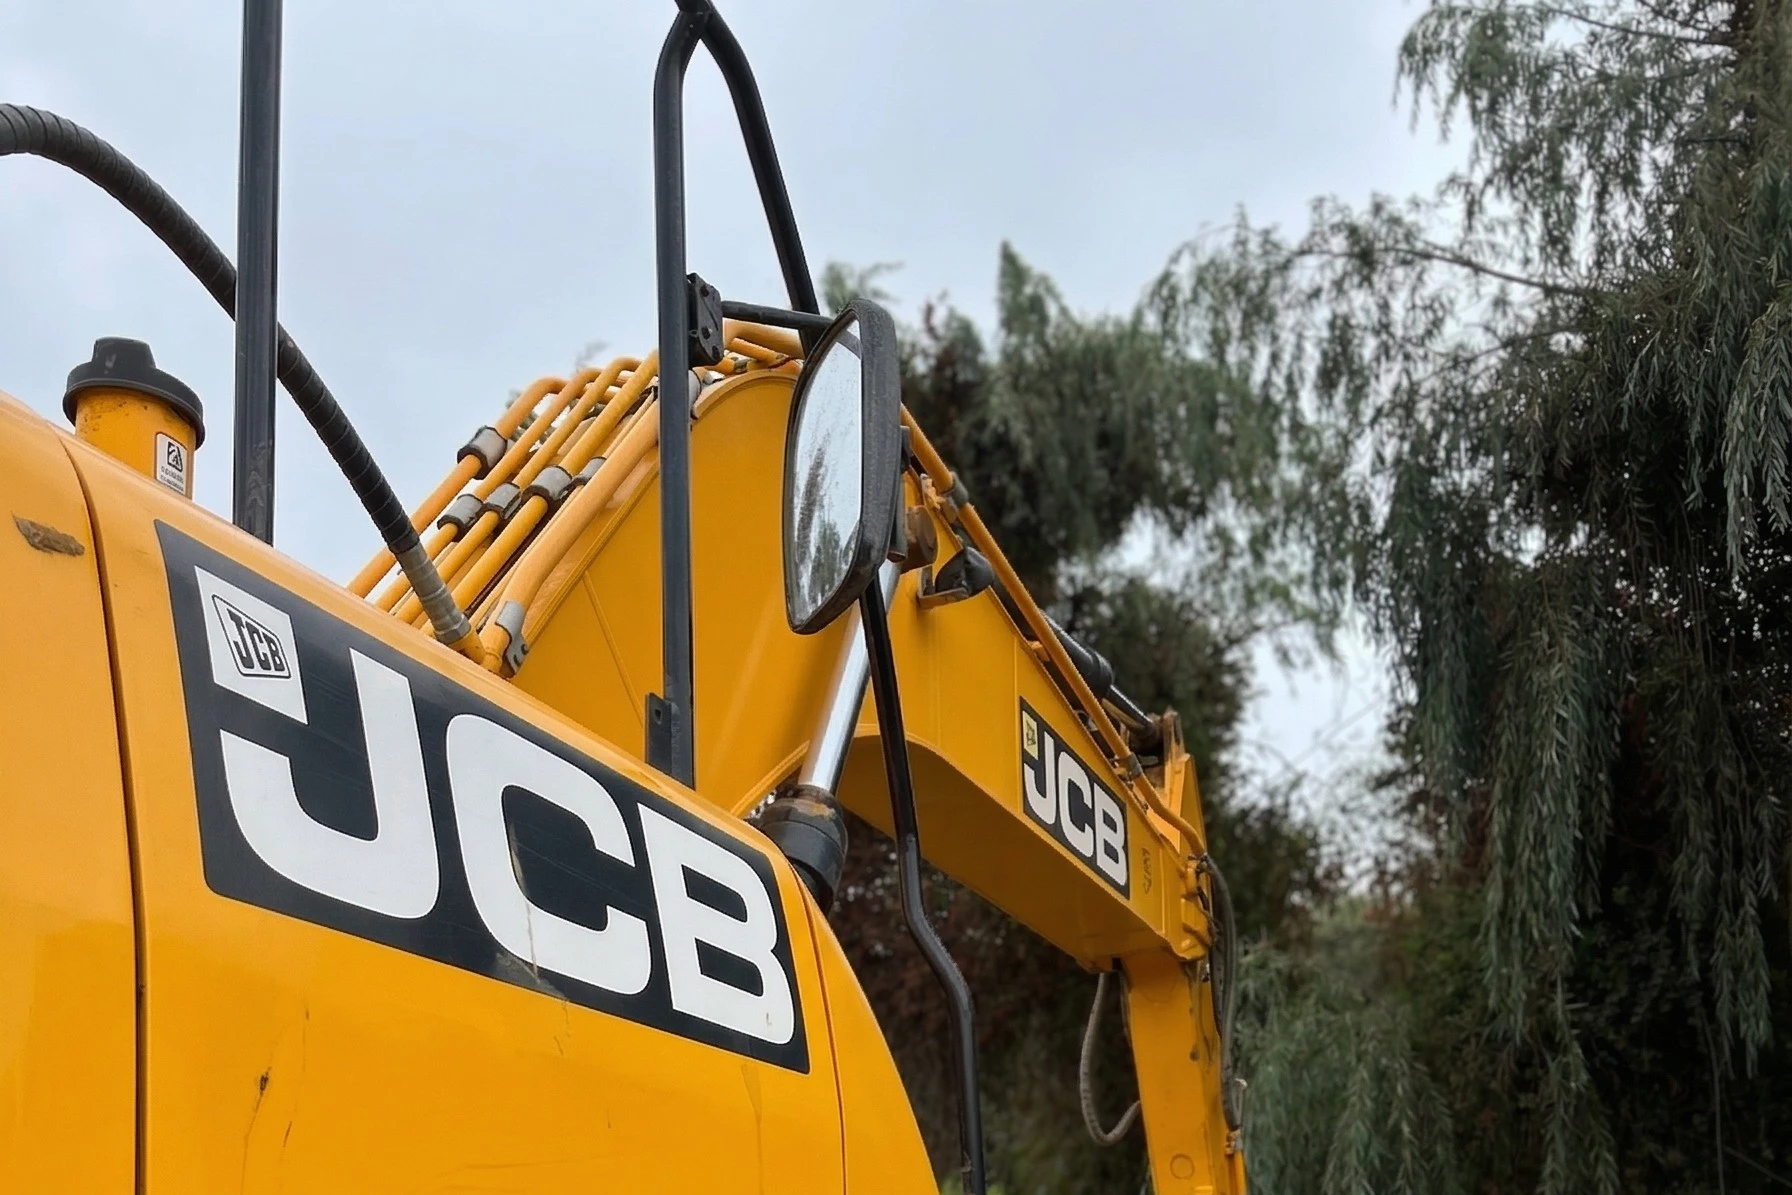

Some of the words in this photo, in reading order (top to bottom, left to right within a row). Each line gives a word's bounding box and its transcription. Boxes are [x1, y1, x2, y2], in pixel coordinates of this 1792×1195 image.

[227, 607, 286, 673] JCB
[220, 648, 795, 1045] JCB
[1024, 731, 1127, 886] JCB
